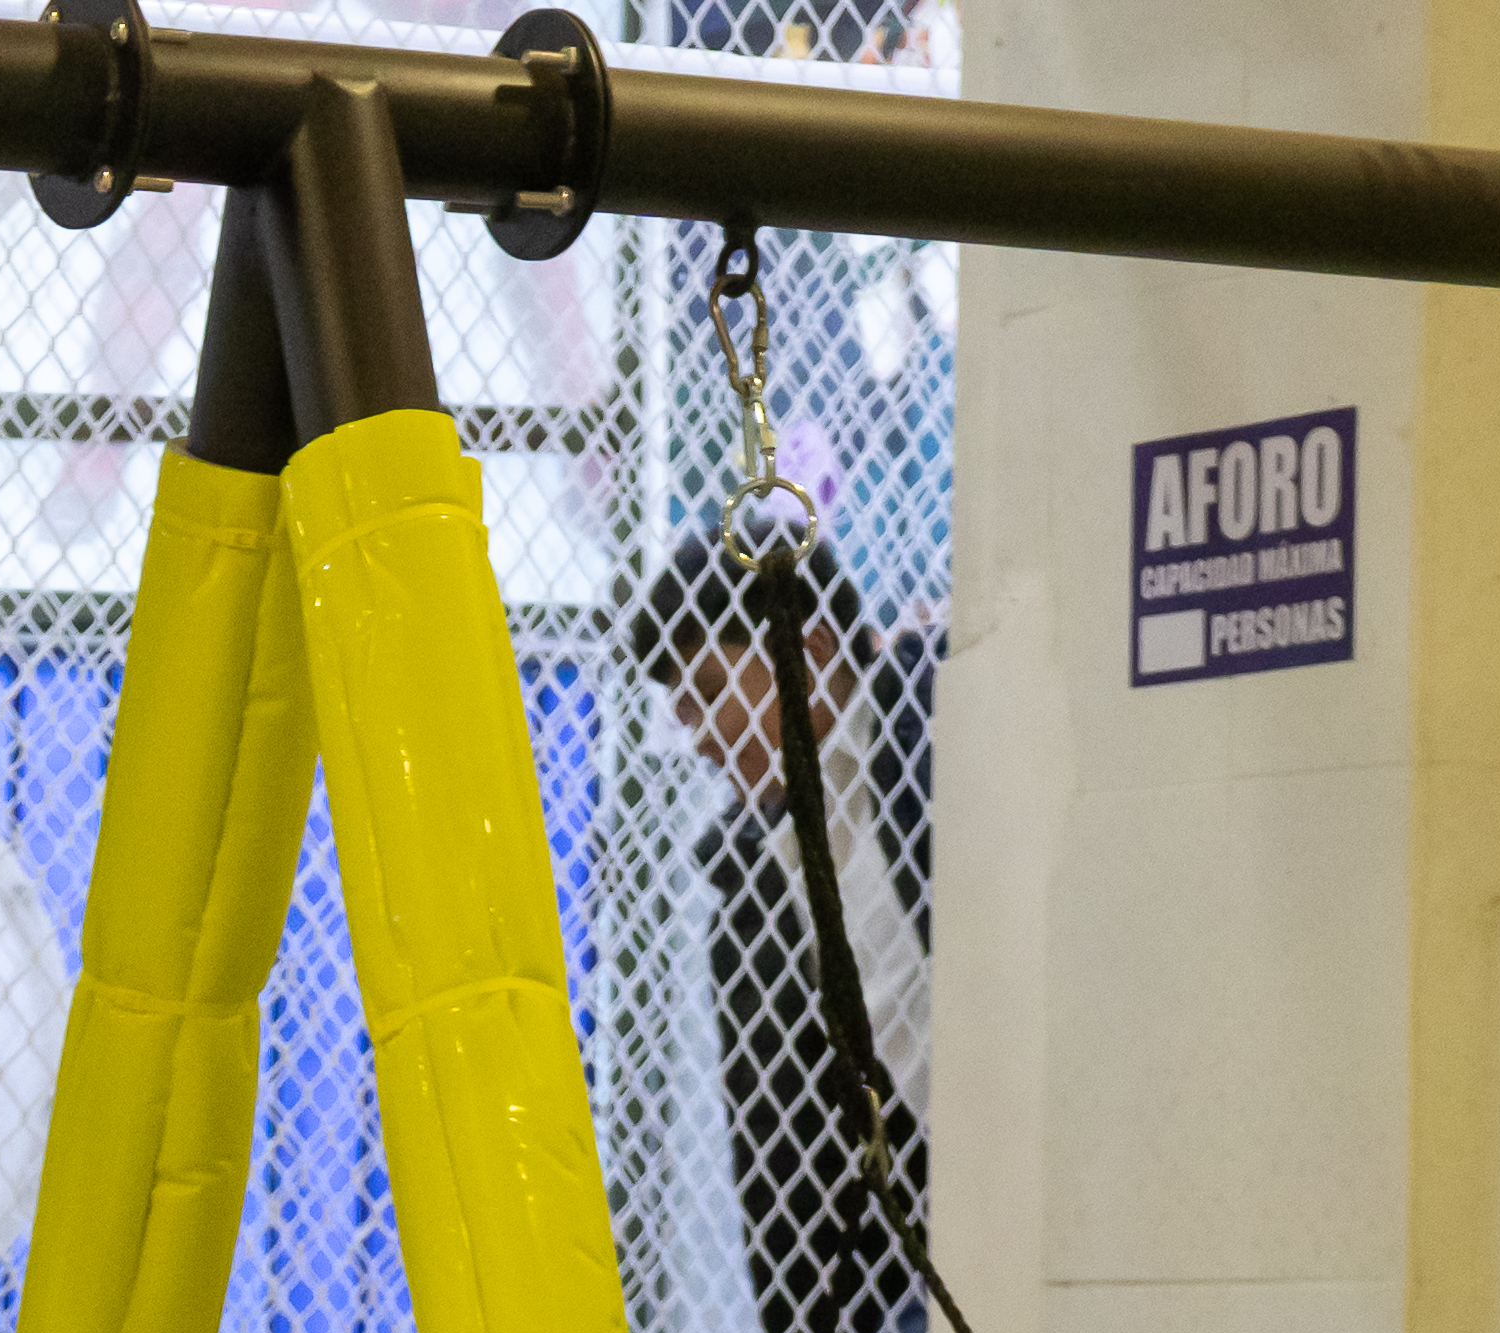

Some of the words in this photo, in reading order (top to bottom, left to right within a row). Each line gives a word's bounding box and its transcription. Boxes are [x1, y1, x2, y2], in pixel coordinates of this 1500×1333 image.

[1145, 425, 1342, 552] AFORO
[1140, 552, 1256, 600] CAPACIDAD
[1210, 596, 1346, 656] PERSONAS
